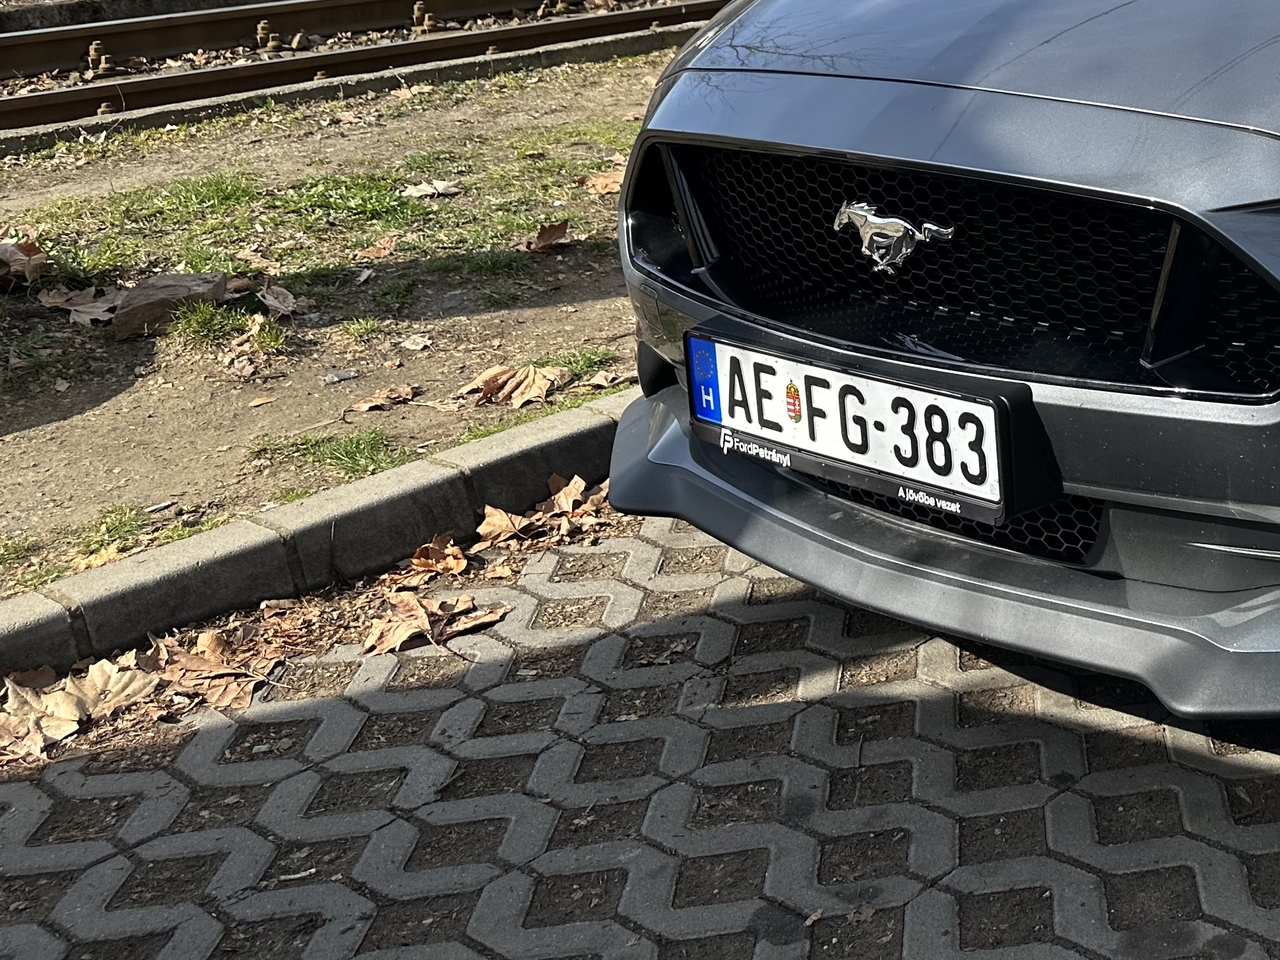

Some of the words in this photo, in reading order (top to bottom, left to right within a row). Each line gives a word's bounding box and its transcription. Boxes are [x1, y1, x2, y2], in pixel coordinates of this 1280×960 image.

[701, 385, 715, 410] H
[728, 355, 784, 433] AE
[804, 374, 988, 486] FG-383
[898, 486, 906, 499] A
[935, 497, 962, 514] vezet
